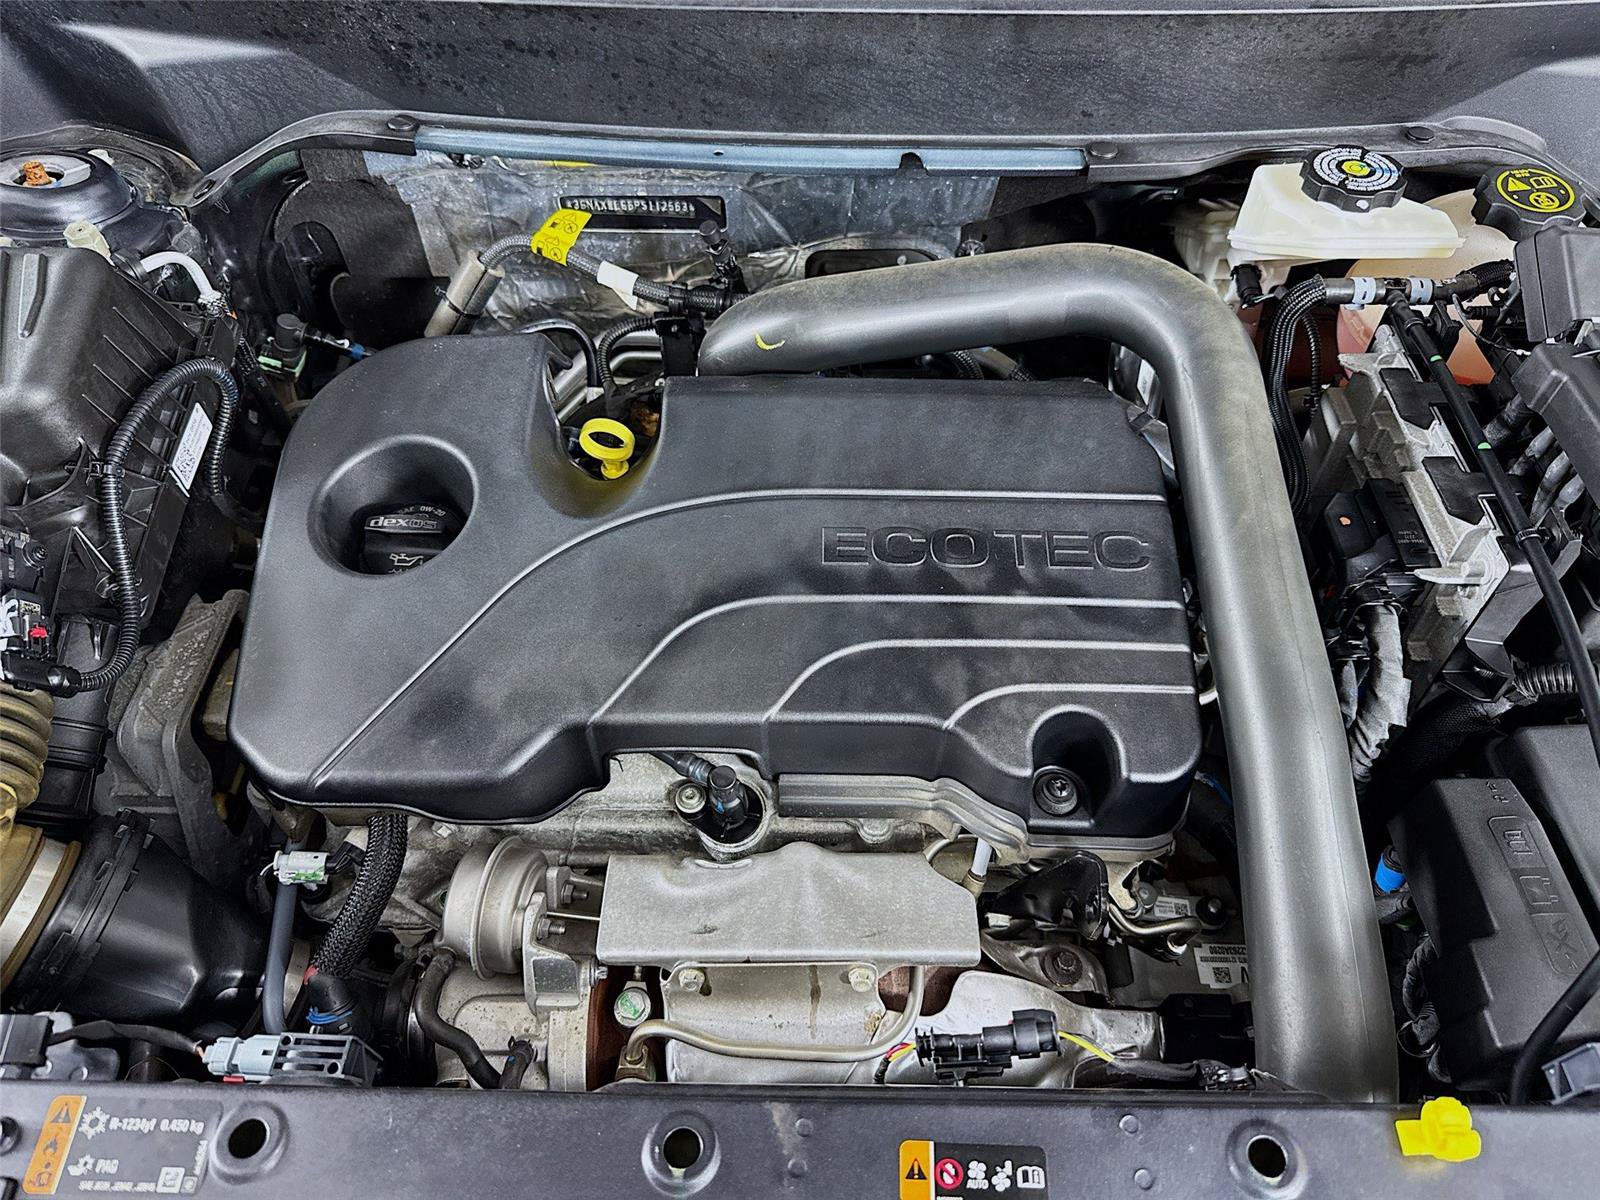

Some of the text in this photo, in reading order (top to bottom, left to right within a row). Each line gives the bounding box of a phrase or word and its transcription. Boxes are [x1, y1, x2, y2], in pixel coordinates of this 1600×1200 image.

[369, 516, 437, 529] dexos
[821, 526, 1151, 572] ECOTEC
[966, 1179, 989, 1190] AUTO
